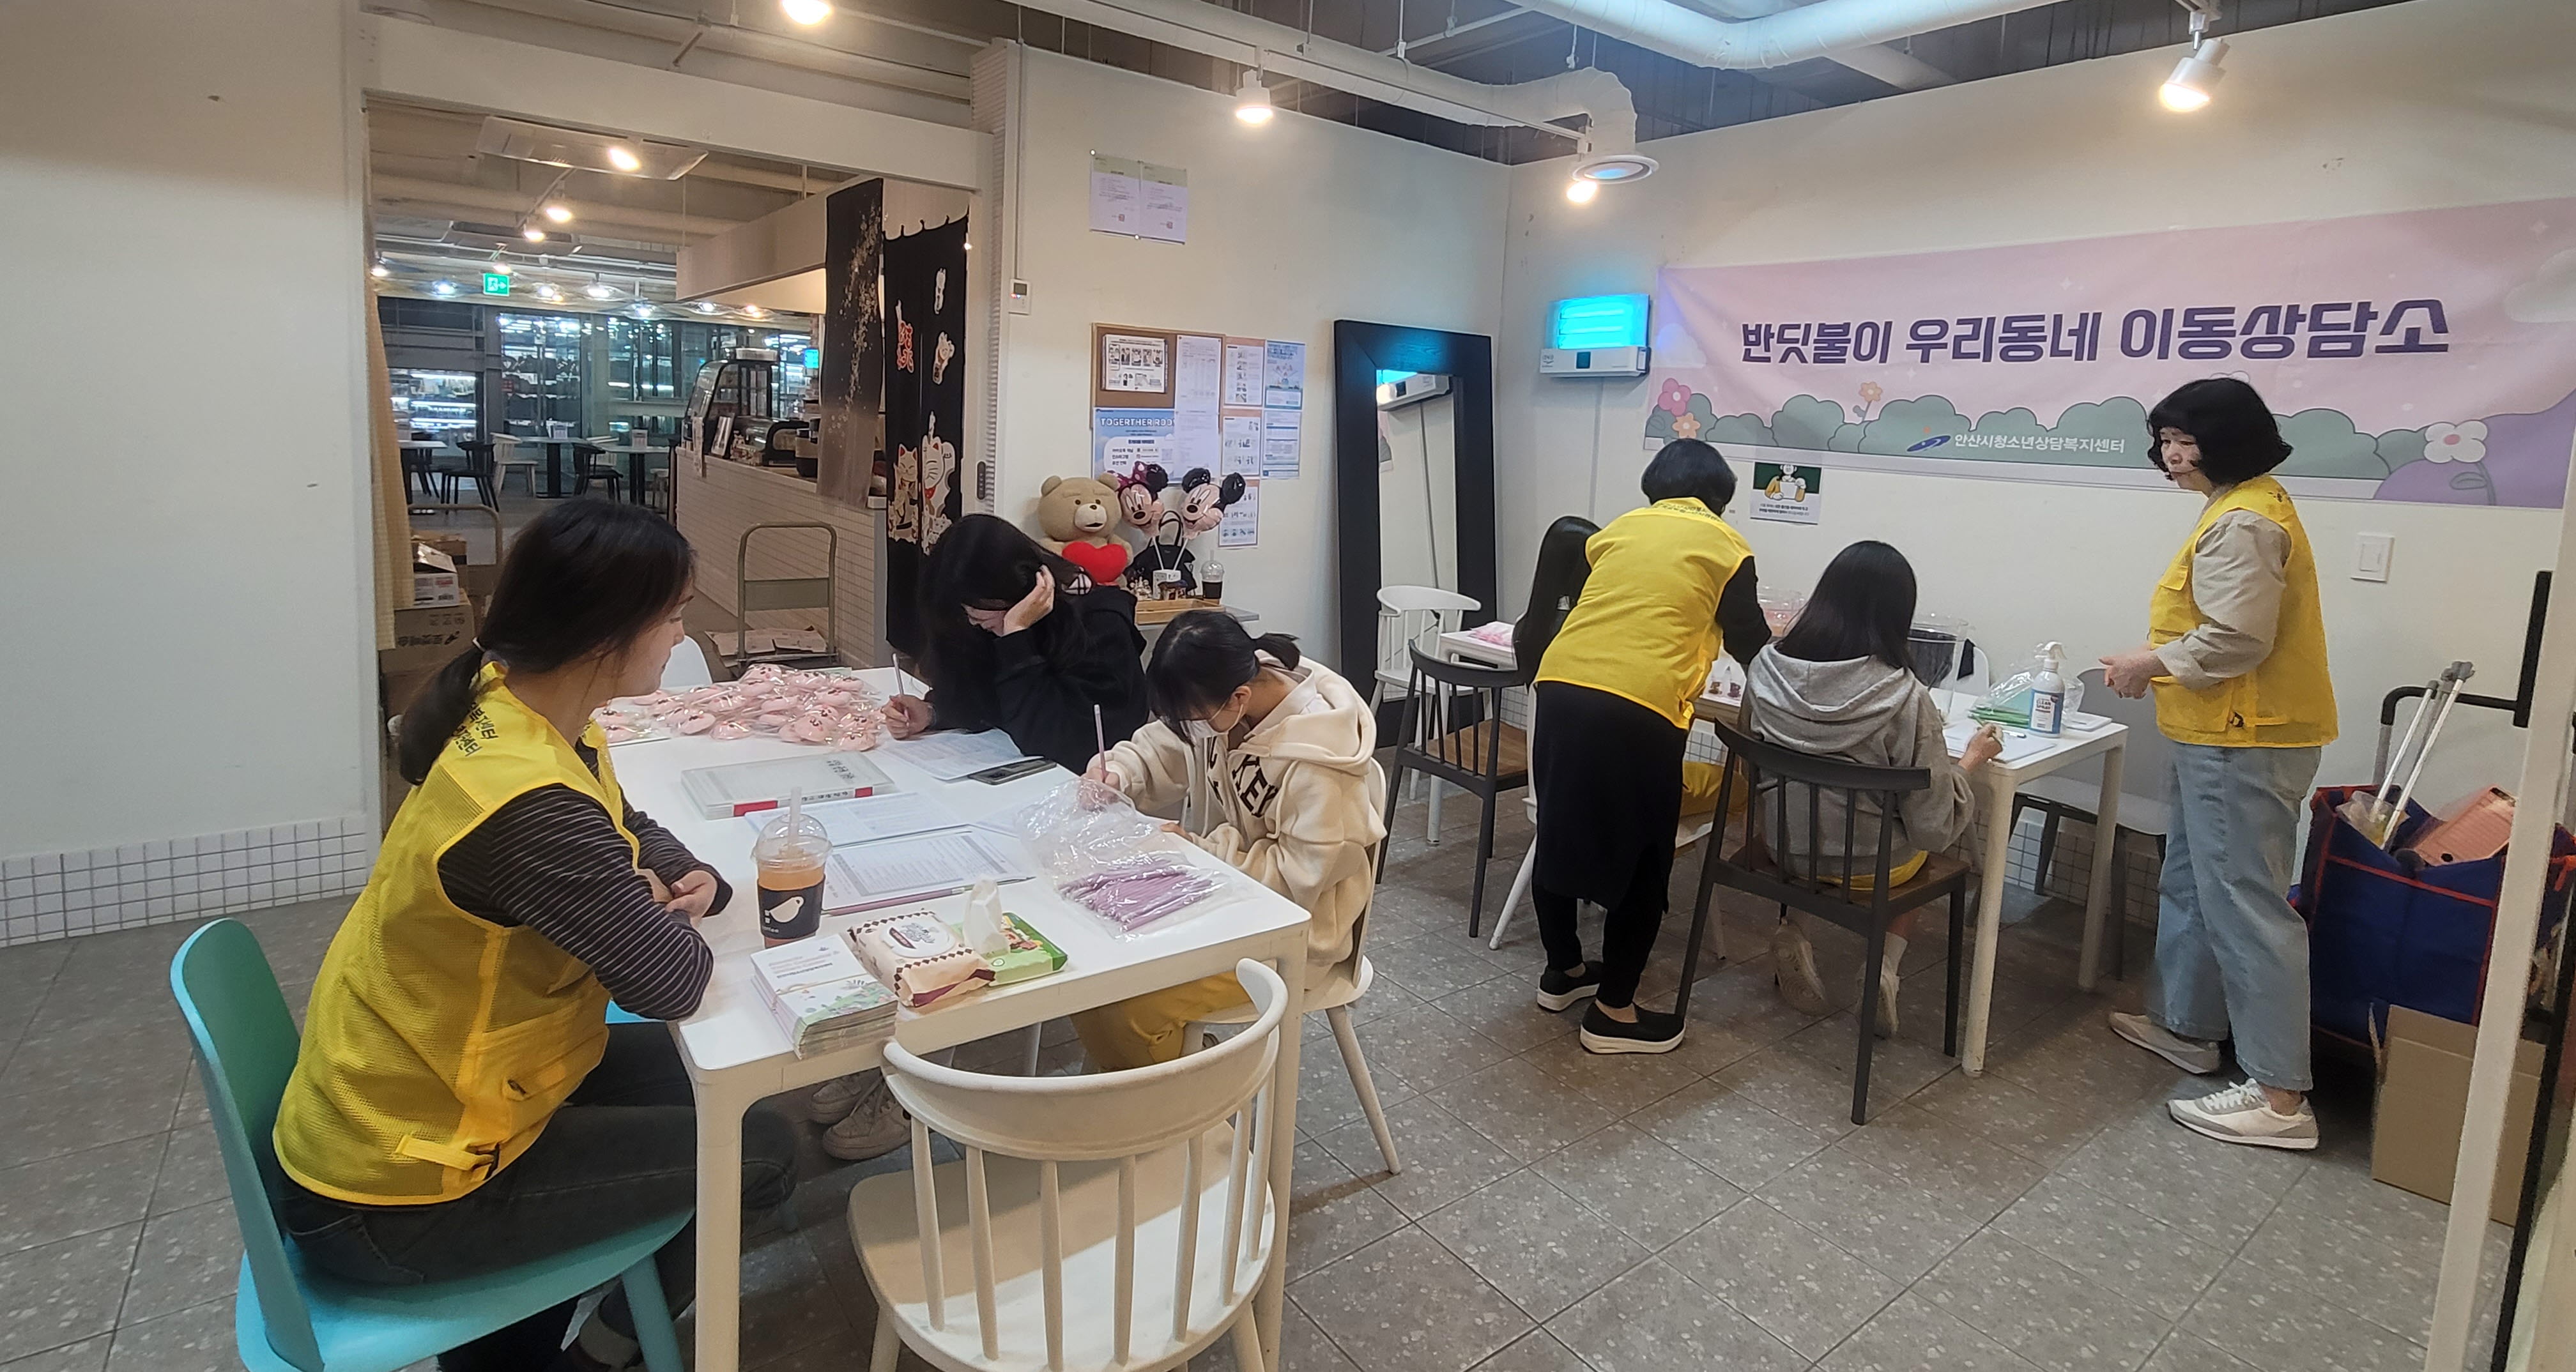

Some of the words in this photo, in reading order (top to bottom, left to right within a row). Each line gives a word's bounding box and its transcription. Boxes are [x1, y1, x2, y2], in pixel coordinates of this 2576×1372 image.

[1741, 321, 1892, 364] 반딧불이
[1905, 312, 2102, 363] 우리동네
[2120, 298, 2450, 360] 이동상담소
[1954, 434, 2126, 454] 안산시청소년상담복지센터
